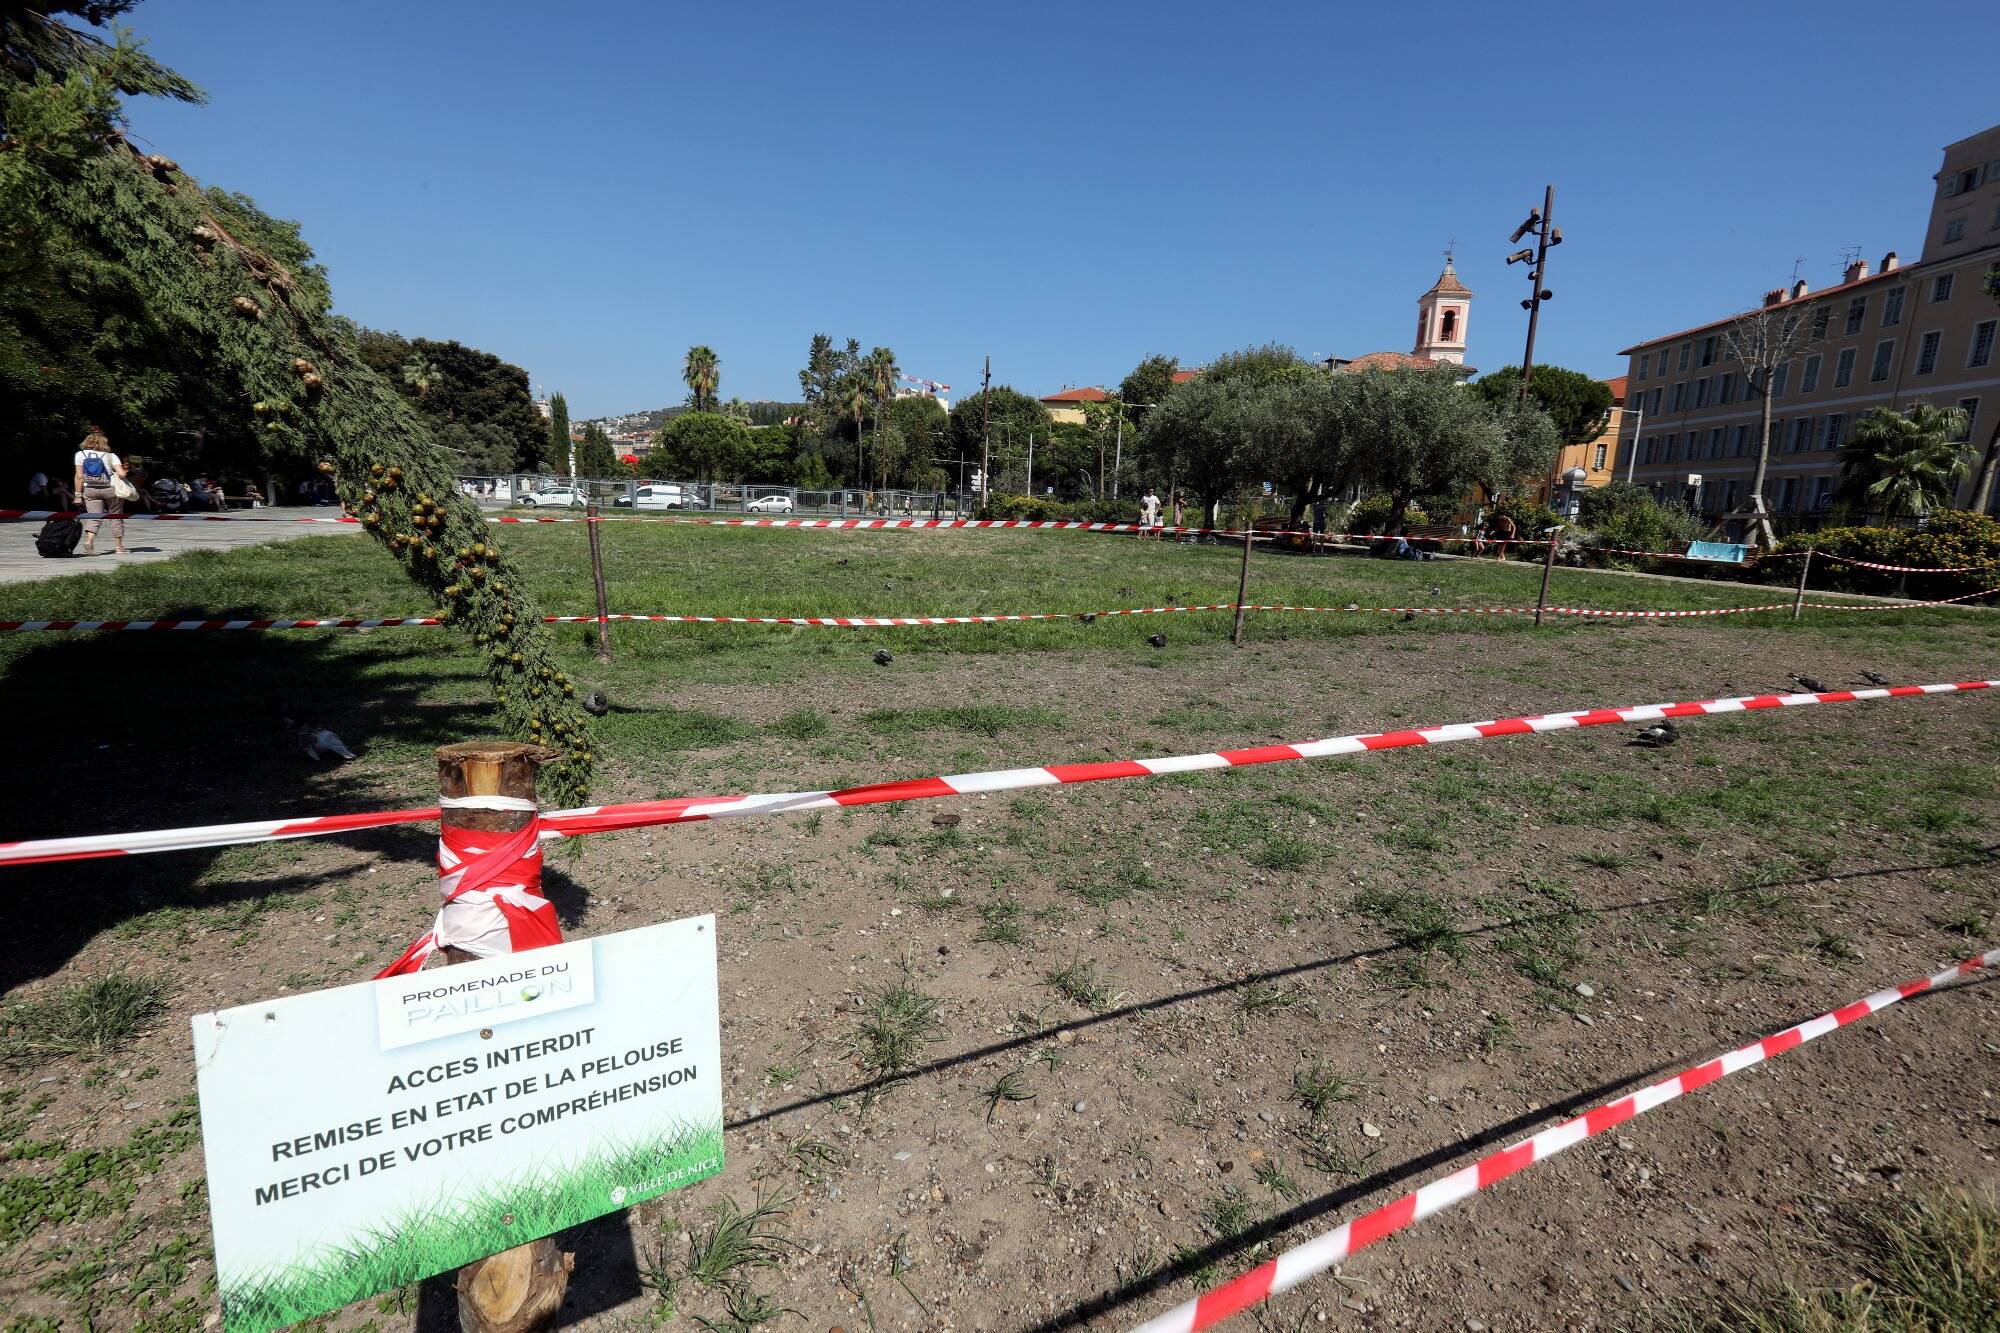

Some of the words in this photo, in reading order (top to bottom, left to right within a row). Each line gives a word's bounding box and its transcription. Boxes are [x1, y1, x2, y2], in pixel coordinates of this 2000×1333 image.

[403, 969, 536, 1004] PROMENADE
[542, 962, 569, 977] DU
[407, 976, 573, 1028] PAILLON
[387, 1057, 478, 1095] ACCES
[487, 1028, 595, 1070] INTERDIT
[272, 1117, 383, 1162] REMISE
[391, 1104, 428, 1130] EN
[436, 1086, 497, 1118] ETAT
[505, 1076, 538, 1100] DE
[545, 1067, 576, 1088] LA
[582, 1037, 683, 1079] PELOUSE
[255, 1164, 350, 1206] MERCI
[359, 1150, 397, 1176] DE
[403, 1123, 493, 1161] VOTRE
[500, 1065, 698, 1134] COMPRÉHENSION
[629, 1175, 665, 1195] VILLE
[667, 1168, 686, 1183] DE
[687, 1156, 719, 1176] NICE
